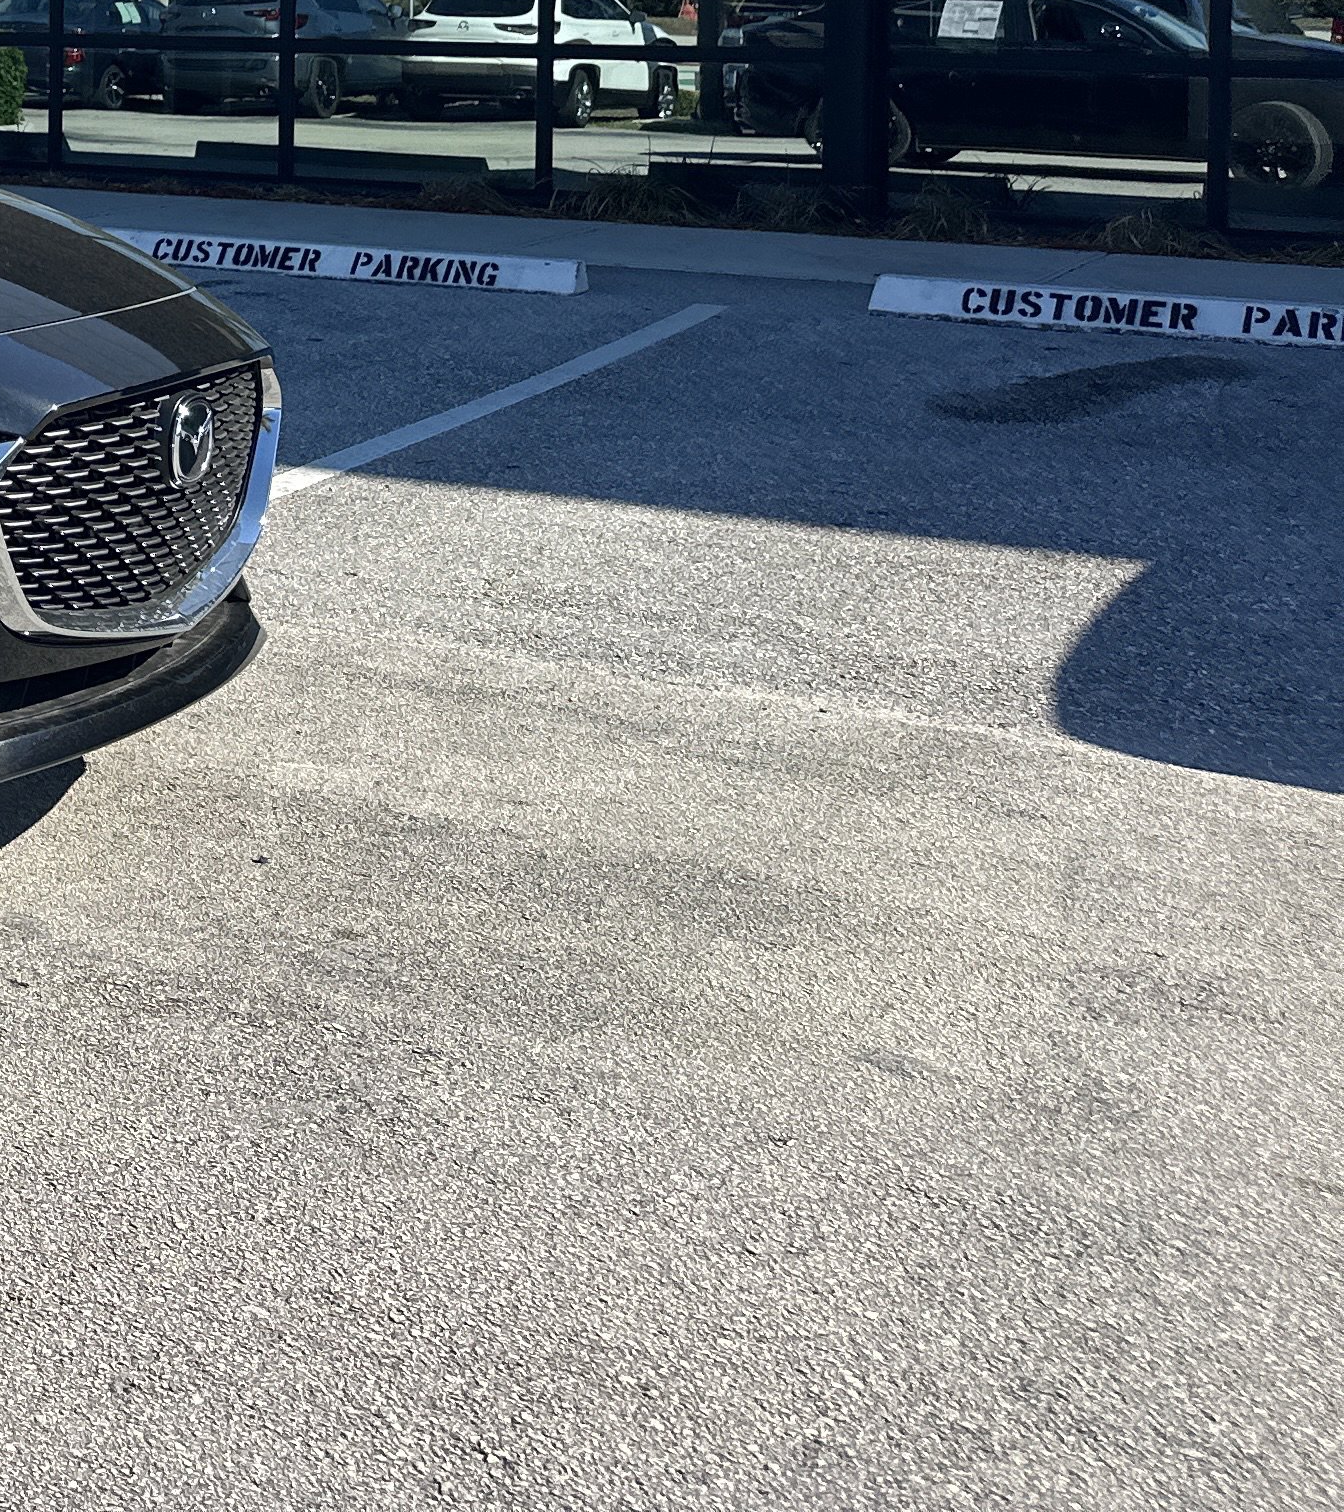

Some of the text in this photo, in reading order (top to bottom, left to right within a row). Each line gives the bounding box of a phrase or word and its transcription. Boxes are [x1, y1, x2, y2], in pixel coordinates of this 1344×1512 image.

[152, 237, 500, 287] CUSTOMER PARKING
[961, 287, 1344, 341] CUSTOMER PAR
